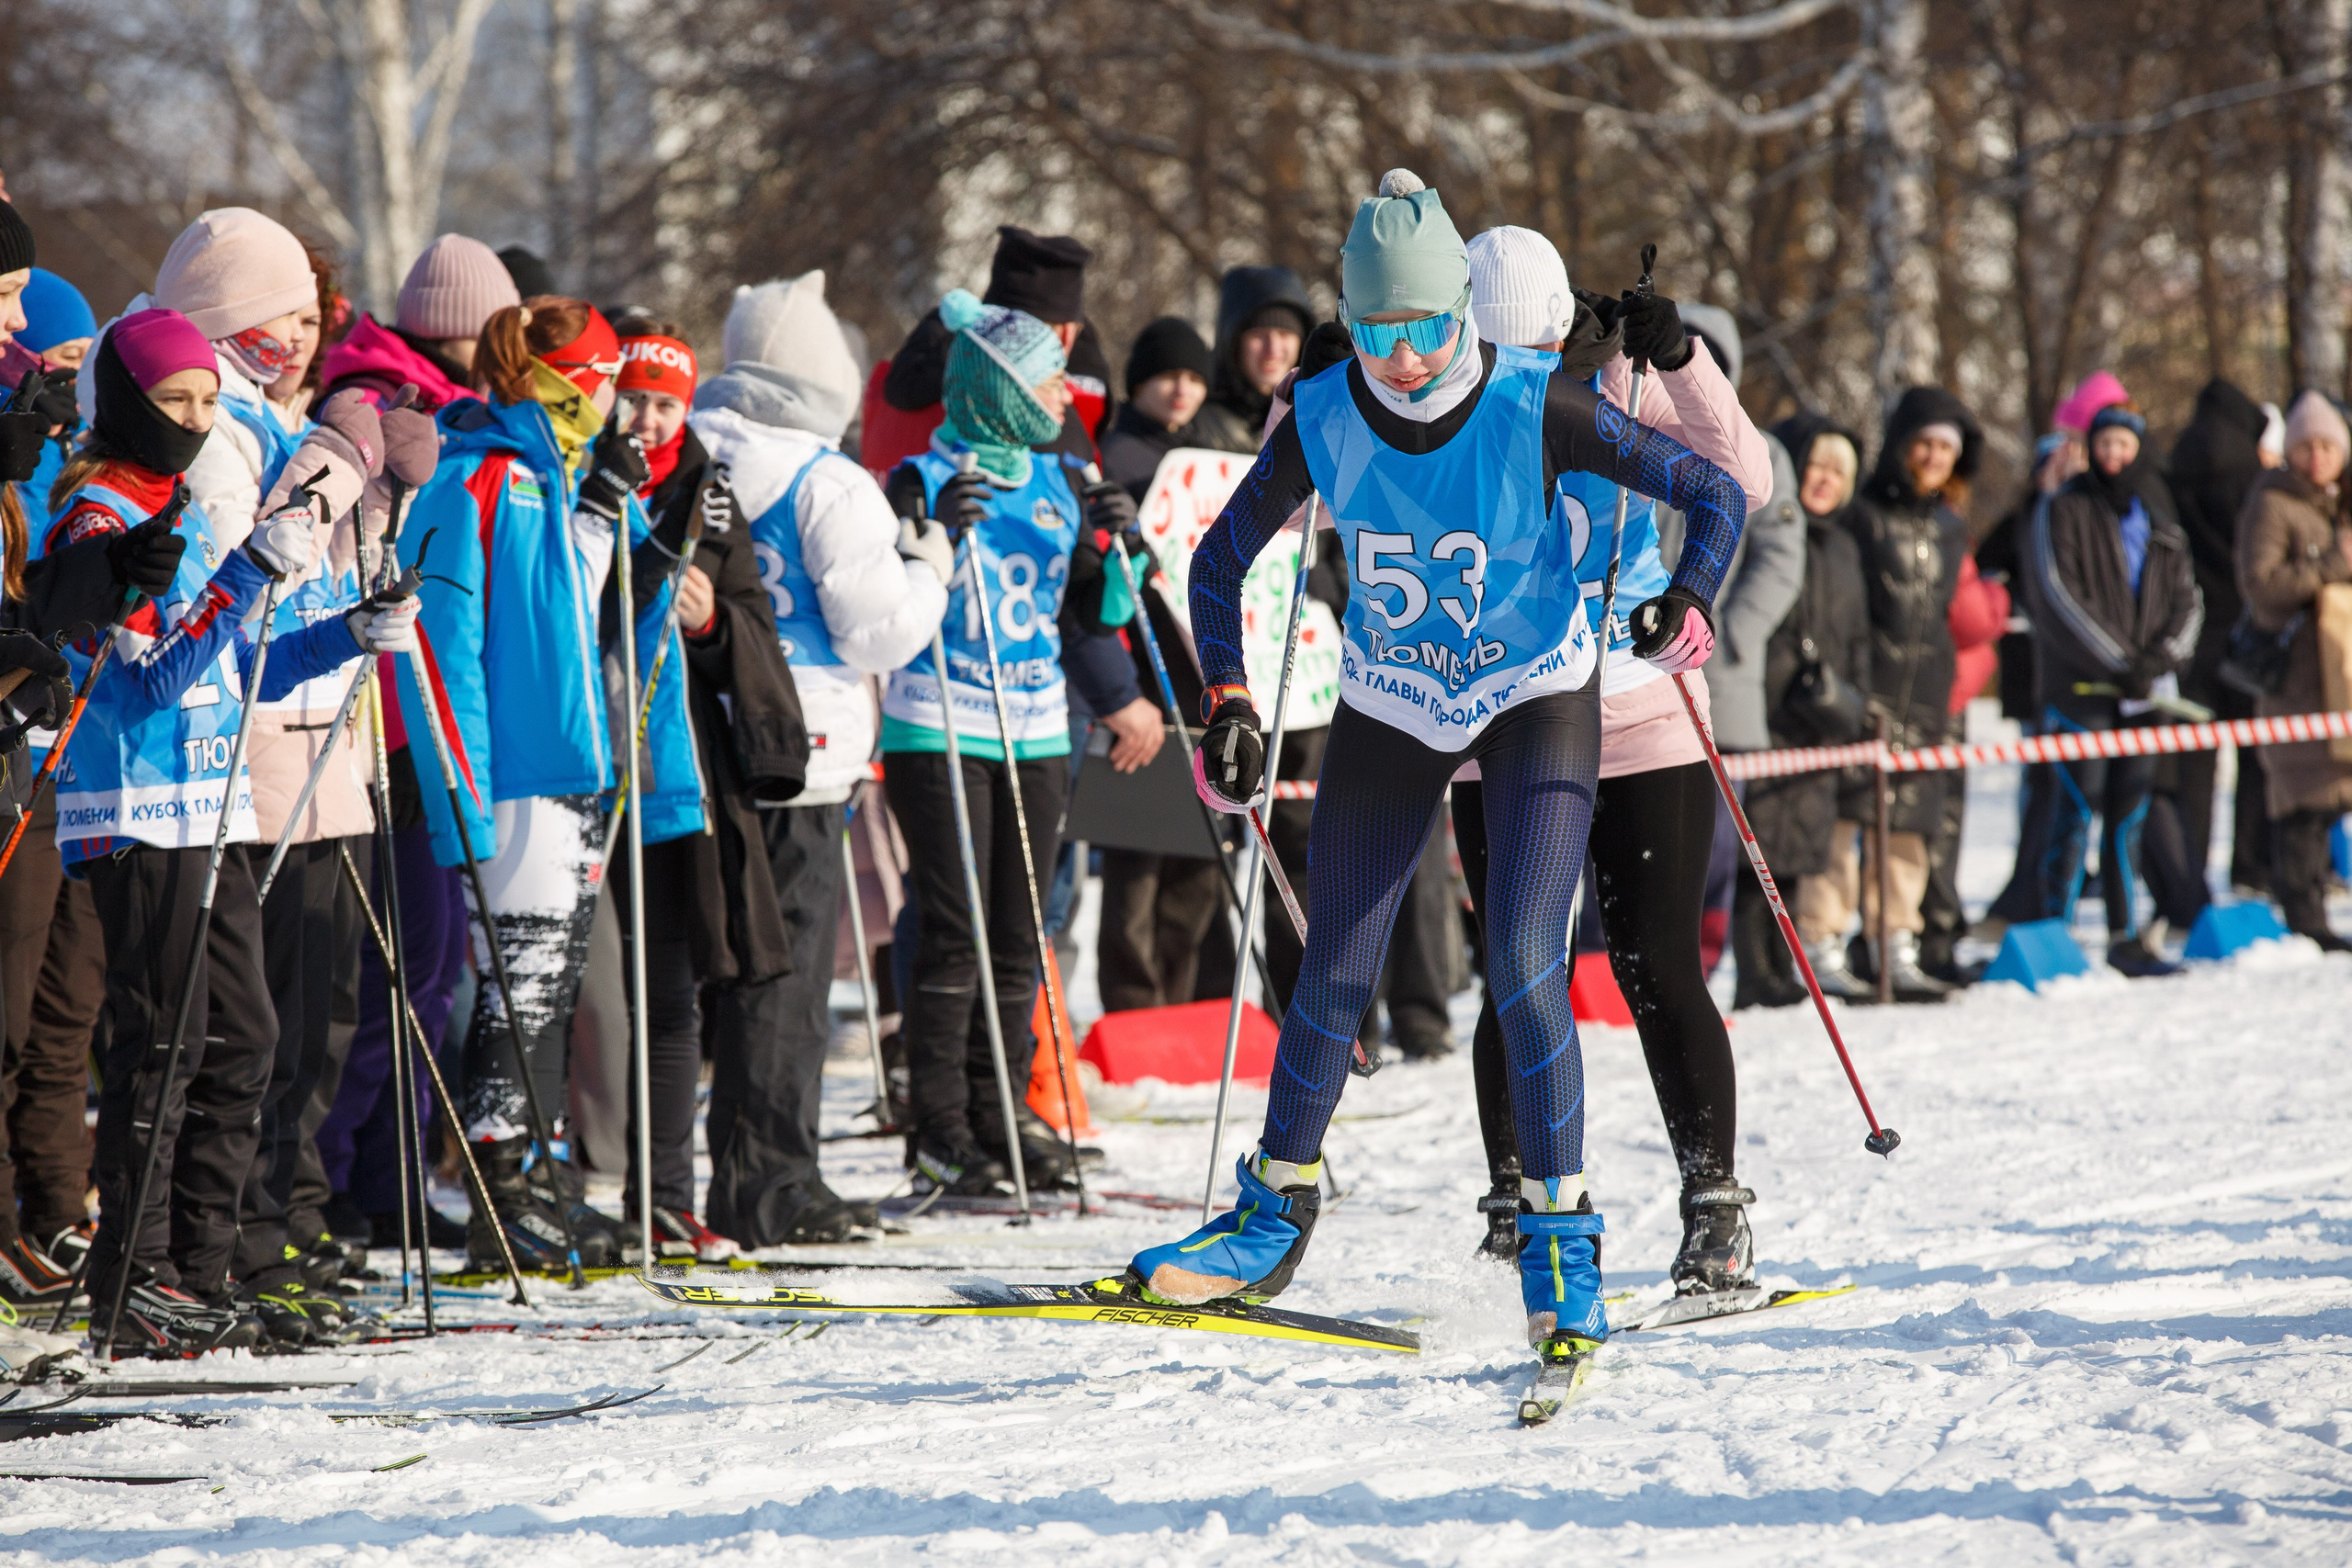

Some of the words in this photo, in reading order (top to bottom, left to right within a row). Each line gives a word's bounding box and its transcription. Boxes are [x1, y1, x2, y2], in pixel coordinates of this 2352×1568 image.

[621, 342, 694, 378] UKOIL
[1356, 527, 1488, 639] 53
[1362, 623, 1507, 691] ТЮМЕНЬ
[1365, 671, 1426, 708] ГЛАВЫ
[1429, 696, 1491, 728] ГОРОДА
[131, 798, 191, 821] КУБОК
[1746, 840, 1790, 919] SWIX
[1690, 1188, 1735, 1205] spine
[128, 1297, 217, 1333] SPINE
[1091, 1308, 1199, 1329] FISCHER
